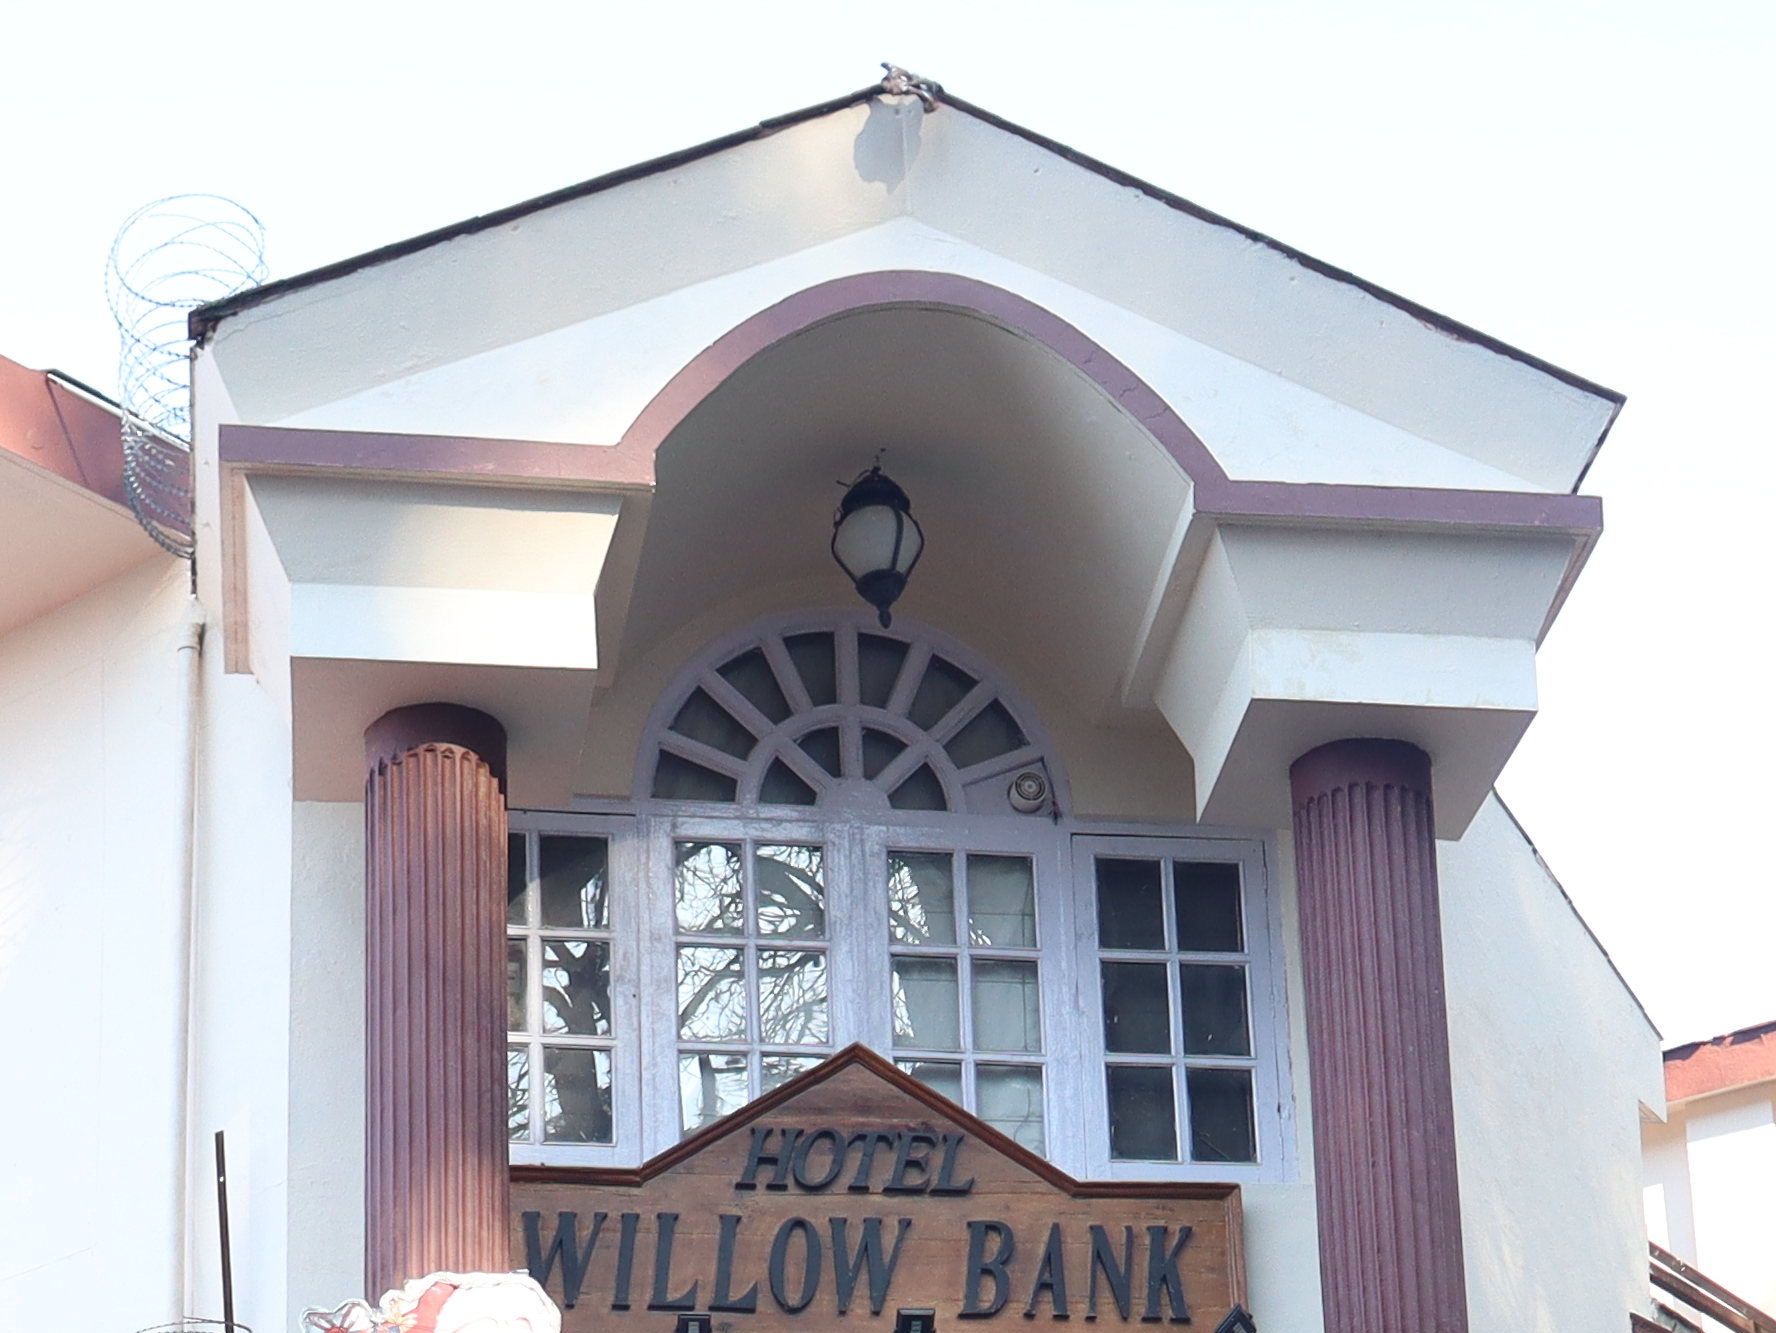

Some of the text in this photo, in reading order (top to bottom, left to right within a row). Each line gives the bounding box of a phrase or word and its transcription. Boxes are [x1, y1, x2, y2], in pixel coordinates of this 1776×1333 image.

[735, 1127, 976, 1196] HOTEL
[521, 1210, 1193, 1324] WILLOW BANK
